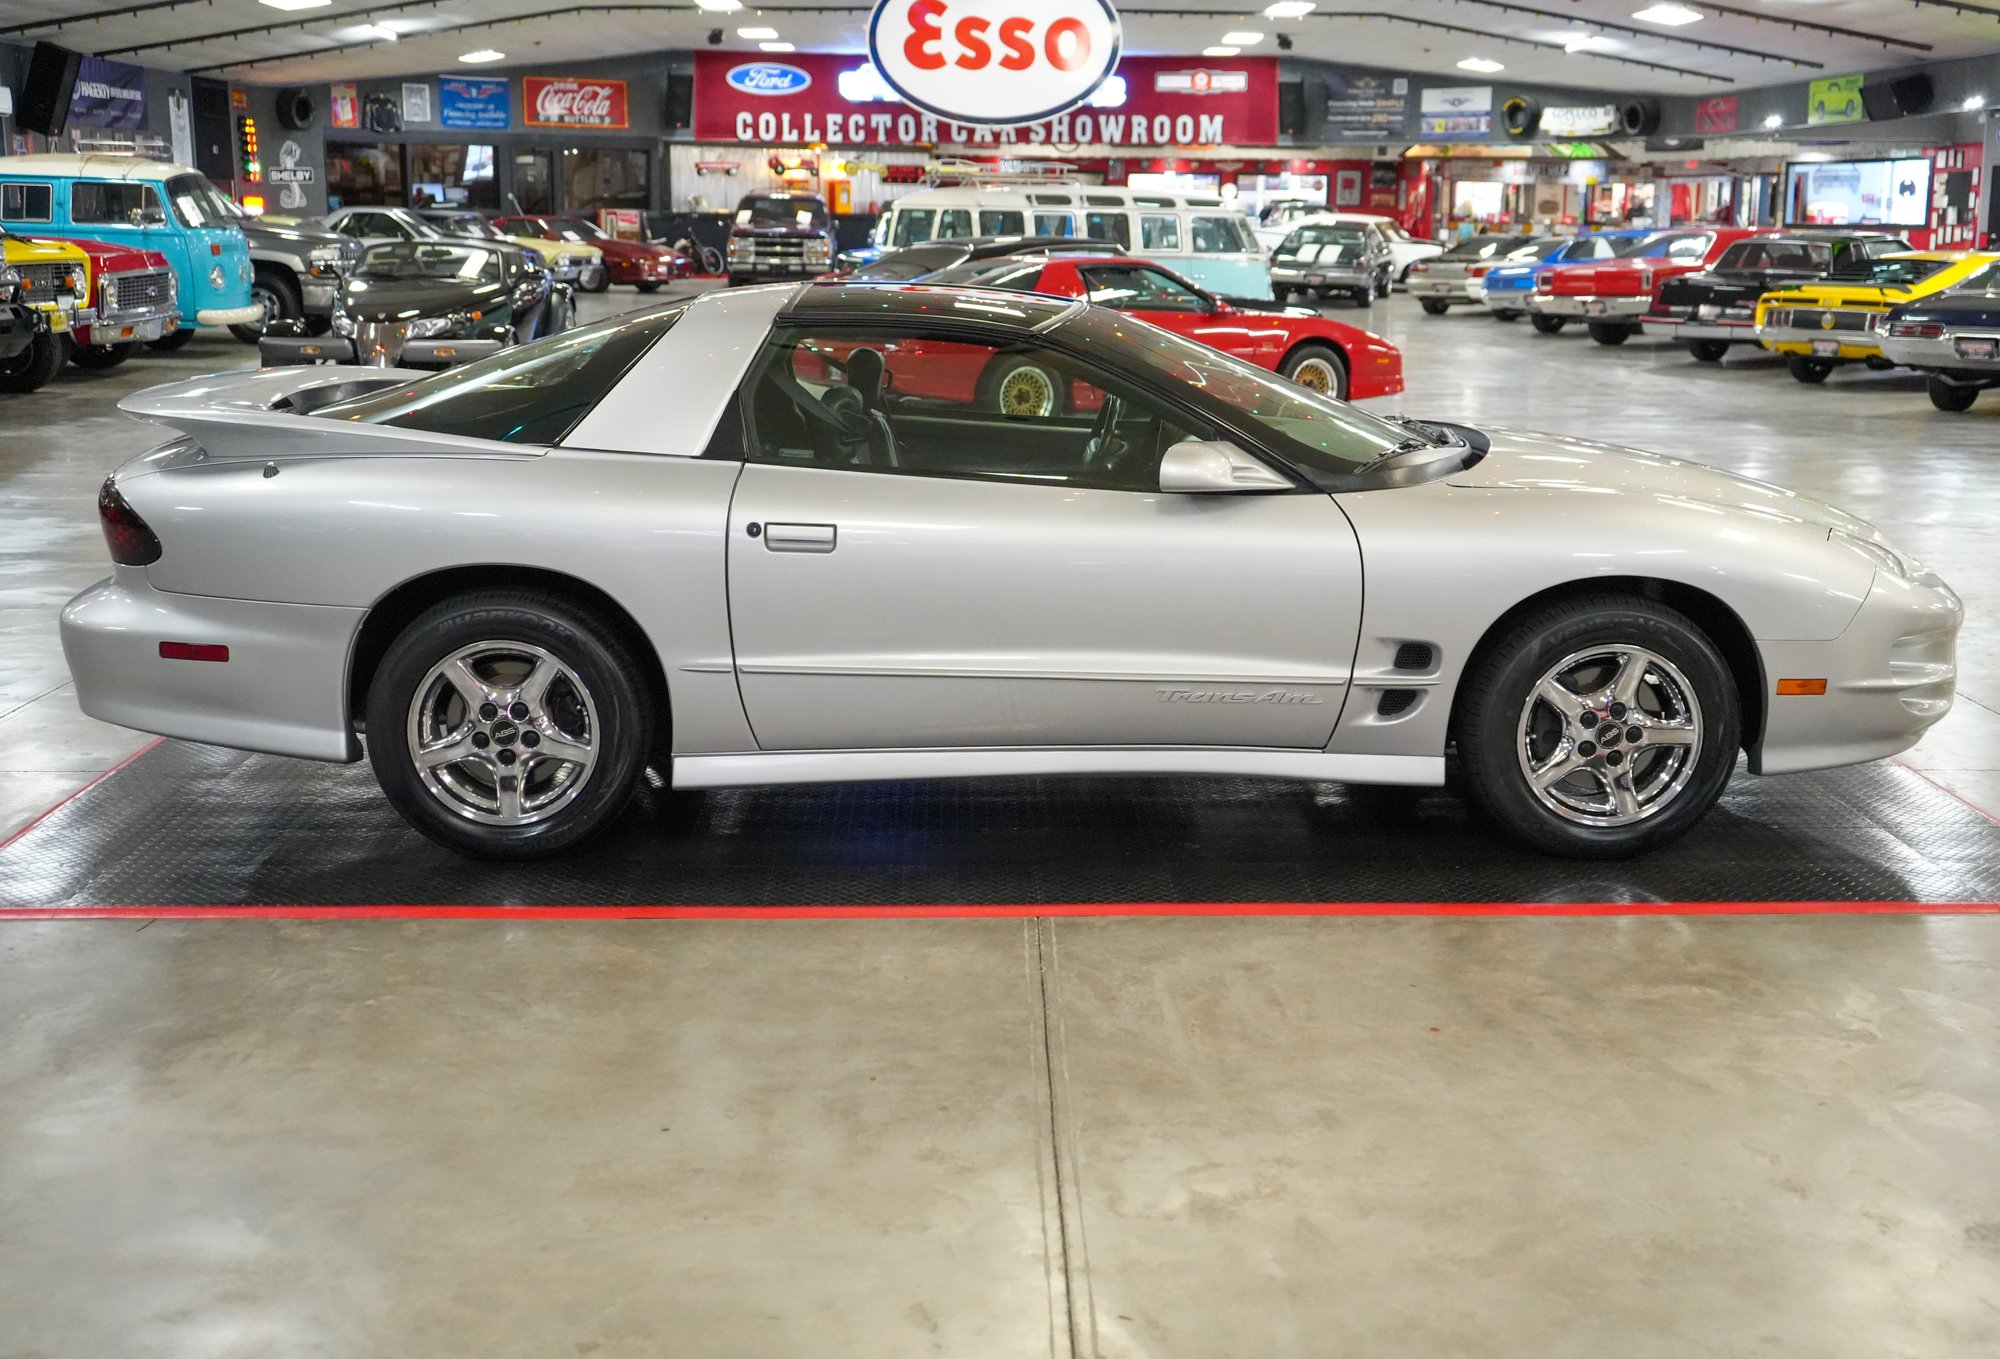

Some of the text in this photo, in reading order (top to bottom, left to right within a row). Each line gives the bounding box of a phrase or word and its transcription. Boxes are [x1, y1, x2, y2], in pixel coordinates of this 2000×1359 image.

[744, 67, 792, 89] Ford
[80, 80, 110, 100] HAGERTY
[536, 83, 614, 117] Coca-Cola
[736, 111, 938, 143] COLLECTOR
[1029, 113, 1224, 144] SHOWROOM
[271, 170, 312, 181] SHELBY
[1600, 727, 1620, 744] ABS
